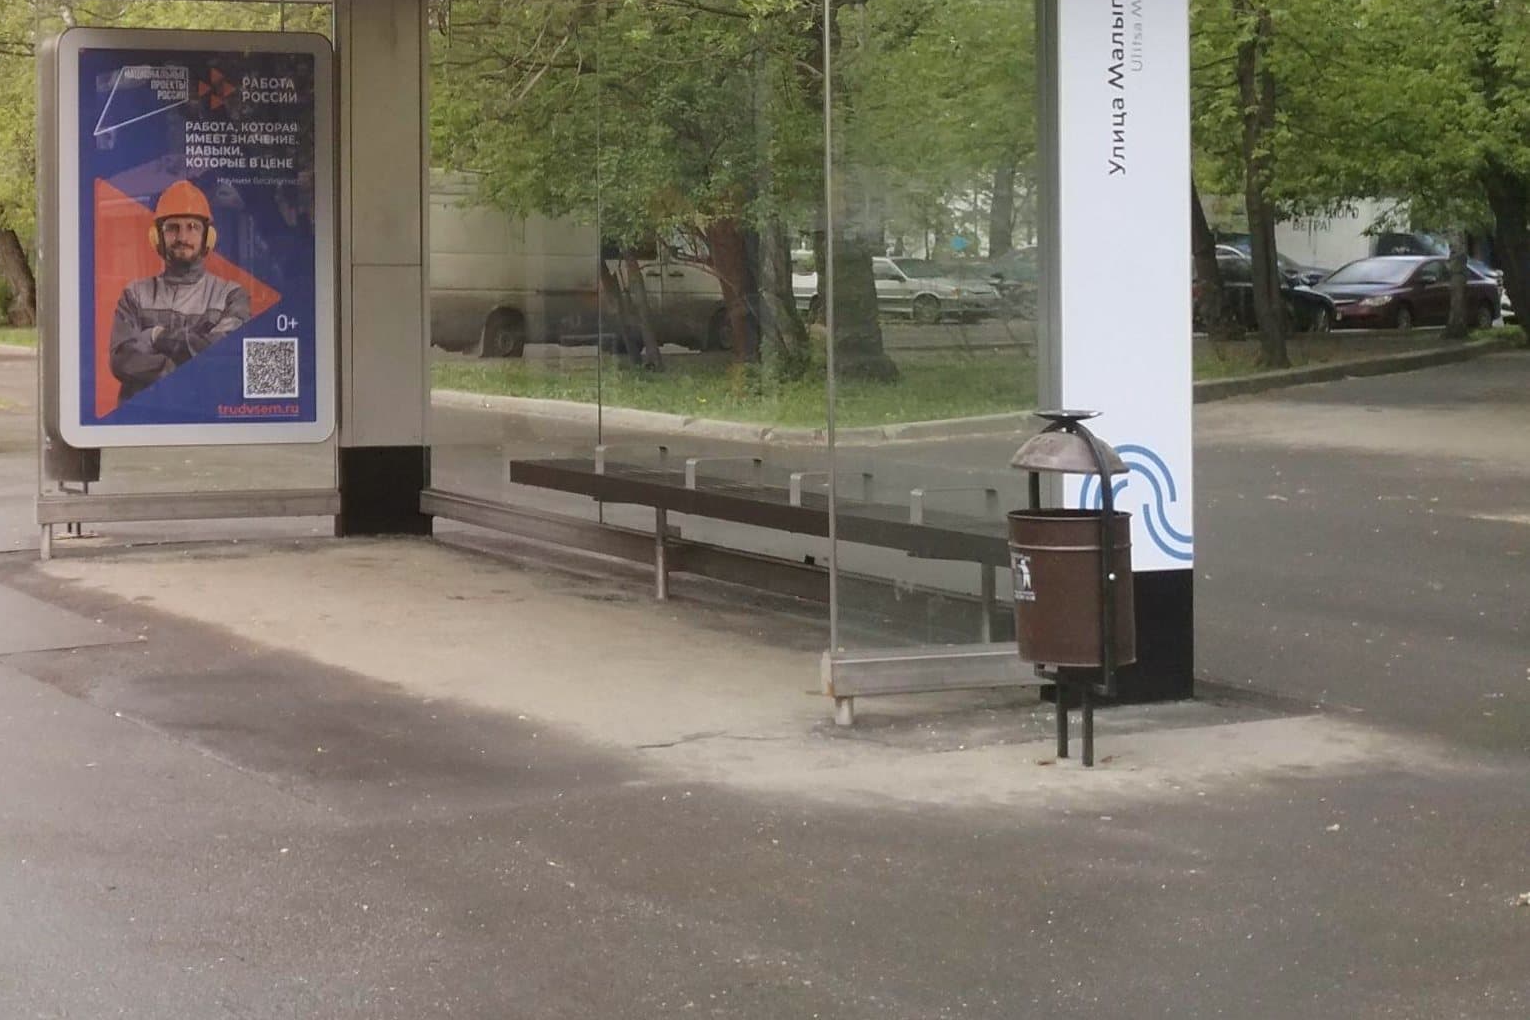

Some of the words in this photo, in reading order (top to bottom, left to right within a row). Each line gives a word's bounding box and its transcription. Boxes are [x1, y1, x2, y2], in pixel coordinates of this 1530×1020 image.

[1130, 22, 1143, 72] Ulitsa
[241, 77, 295, 90] РАБОТА
[241, 91, 298, 104] РОССИИ
[185, 121, 239, 133] РАБОТА,
[241, 122, 298, 133] КОТОРАЯ
[185, 133, 228, 145] ИМЕЕТ
[1107, 97, 1126, 175] Улица
[185, 157, 247, 169] КОТОРЫЕ
[249, 158, 258, 169] В
[260, 158, 294, 171] ЦЕНЕ
[276, 313, 299, 333] 0+
[217, 403, 300, 416] trudvsem.ru
